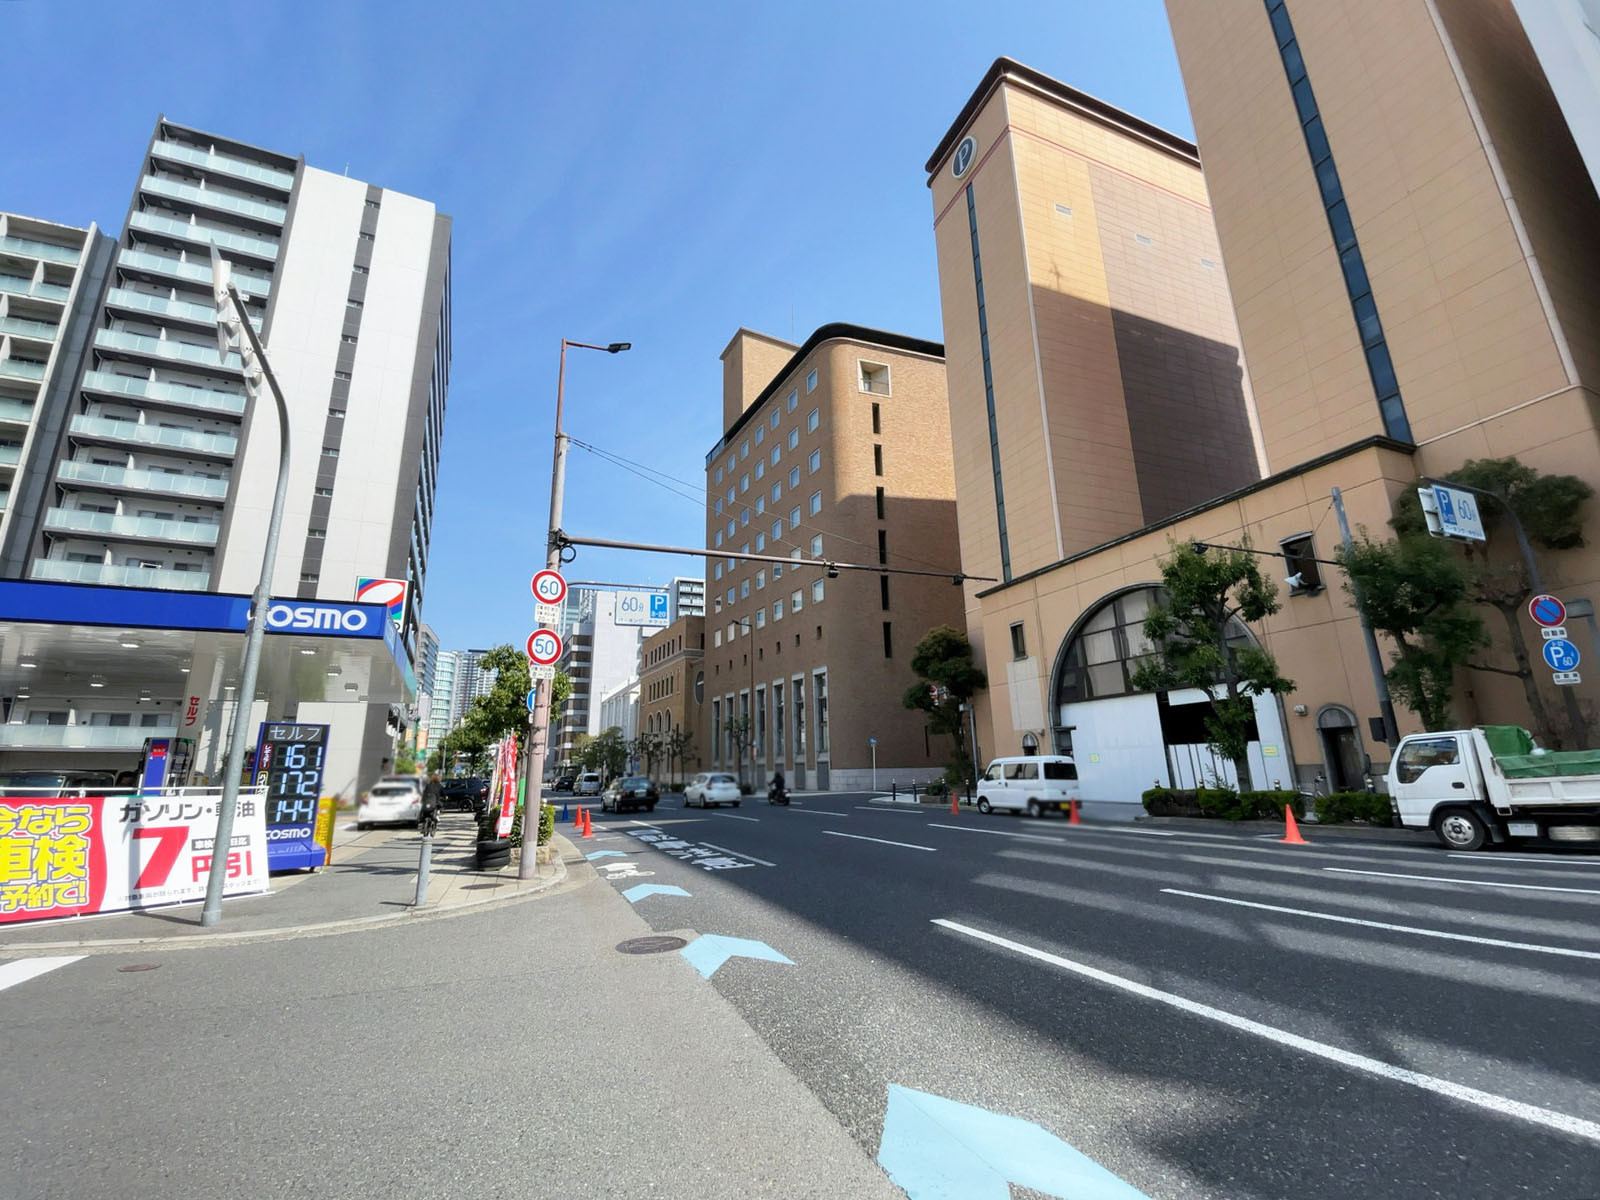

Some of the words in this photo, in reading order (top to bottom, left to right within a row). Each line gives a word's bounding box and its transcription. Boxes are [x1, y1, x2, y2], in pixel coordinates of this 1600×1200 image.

[958, 143, 969, 173] P
[1439, 491, 1449, 511] P
[540, 580, 558, 596] 60
[654, 596, 665, 610] P
[534, 638, 554, 656] 50
[1549, 646, 1564, 667] P
[185, 696, 200, 727] セルフ
[270, 726, 321, 741] セルフ
[284, 744, 323, 769] 161
[279, 771, 319, 796] 172
[275, 799, 315, 823] 144
[132, 825, 190, 890] 7
